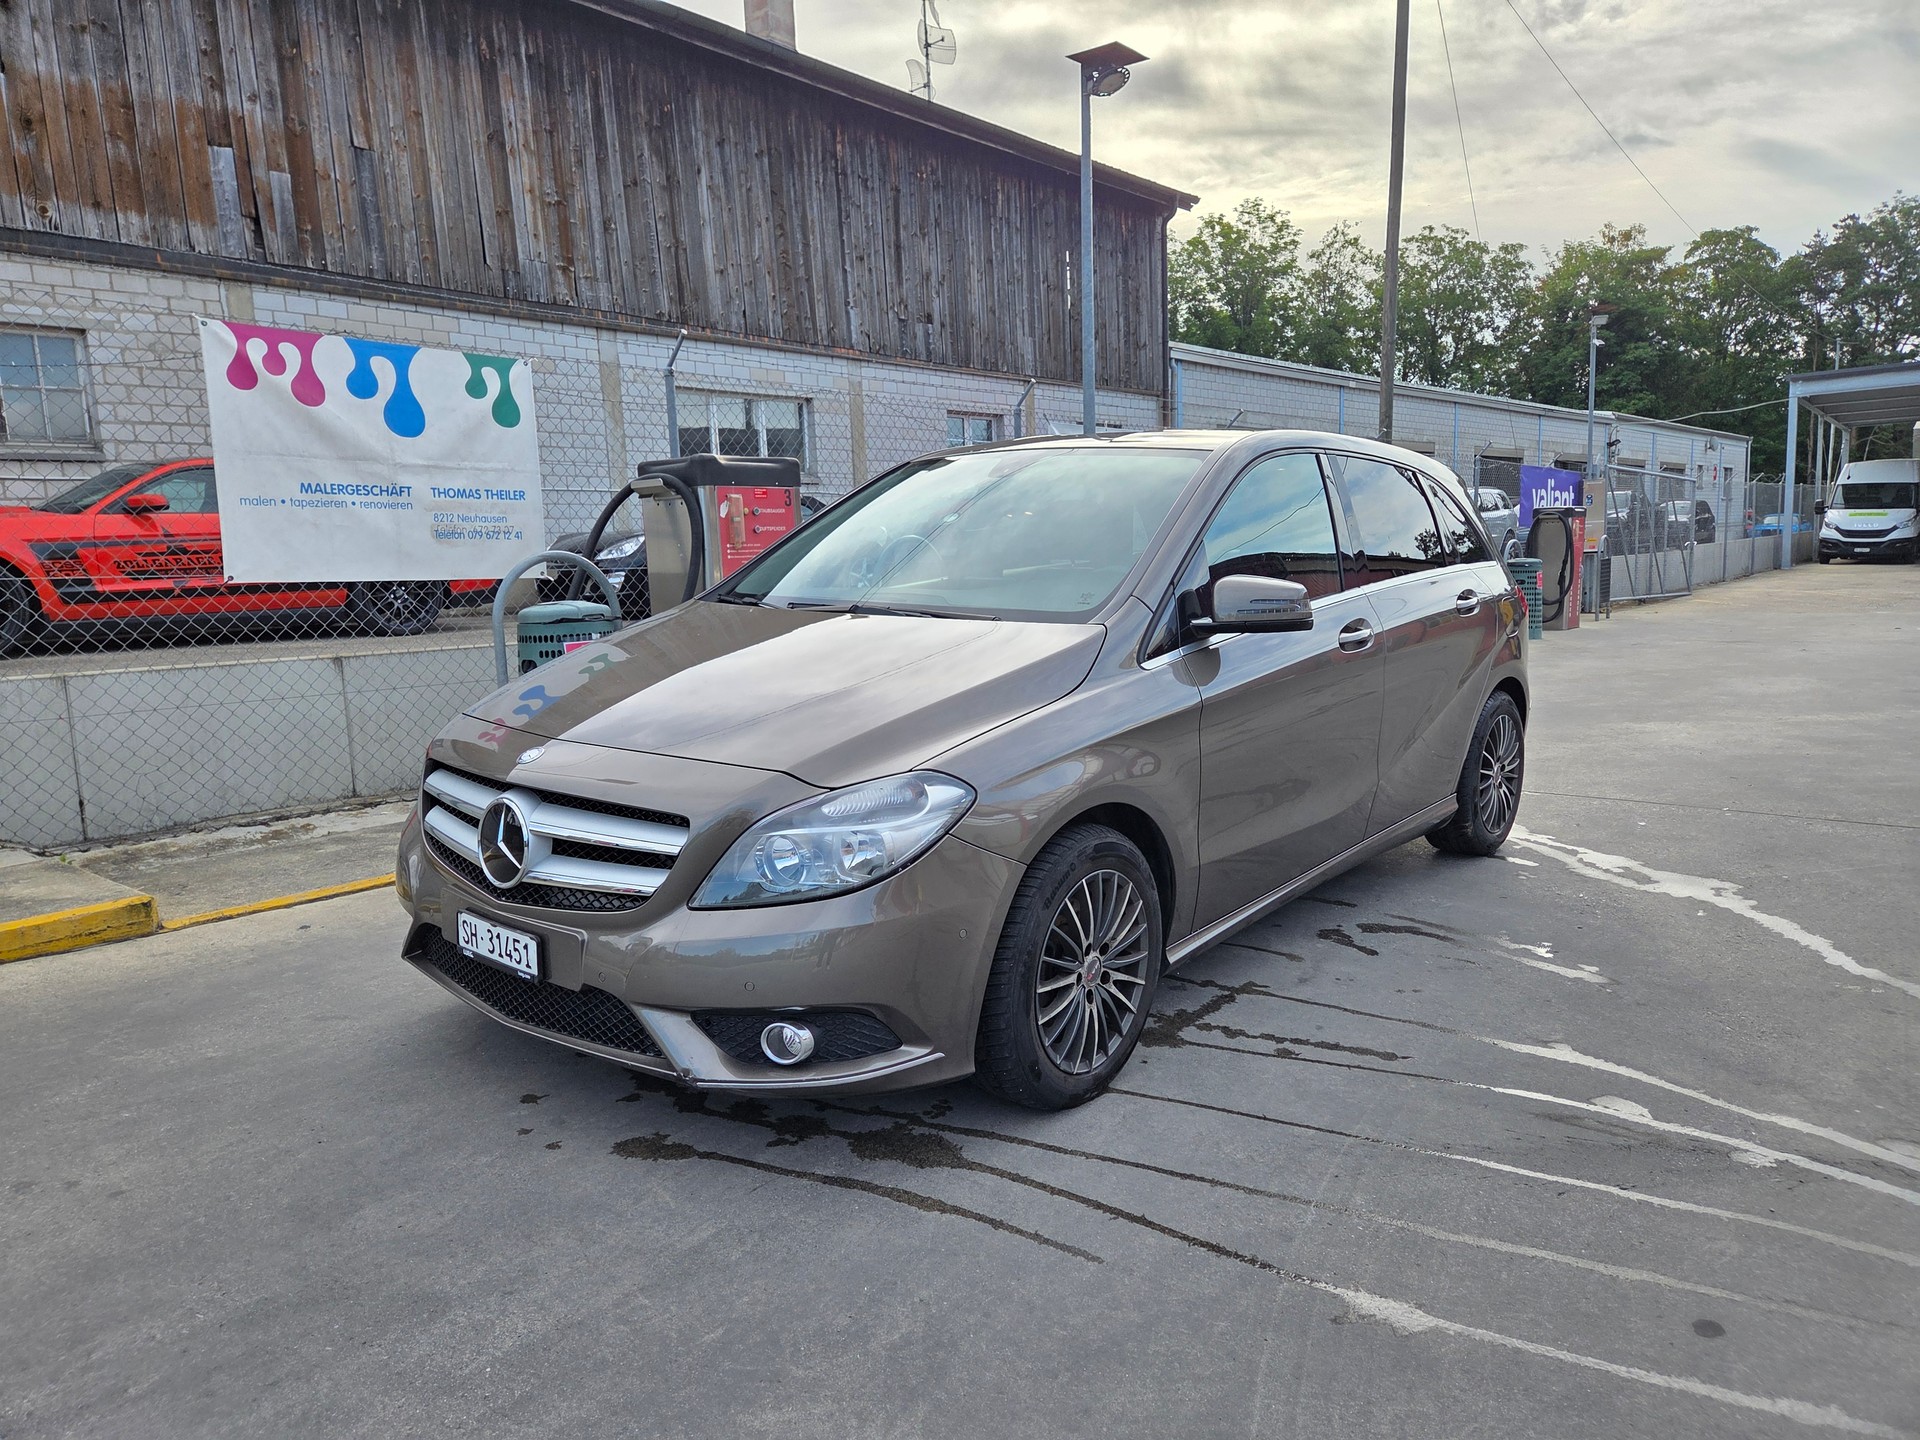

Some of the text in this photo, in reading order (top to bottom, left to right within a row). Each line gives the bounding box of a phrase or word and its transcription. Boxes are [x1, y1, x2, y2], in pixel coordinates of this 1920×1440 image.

[299, 482, 526, 501] MALERGESCHÄFT THOMAS THEILER
[784, 489, 792, 507] 3
[1531, 478, 1574, 507] valiant
[239, 495, 413, 510] malen tapezieren renovieren
[433, 512, 508, 524] 8212 Neuhausen
[433, 529, 523, 541] Telefon 079 672 12 41
